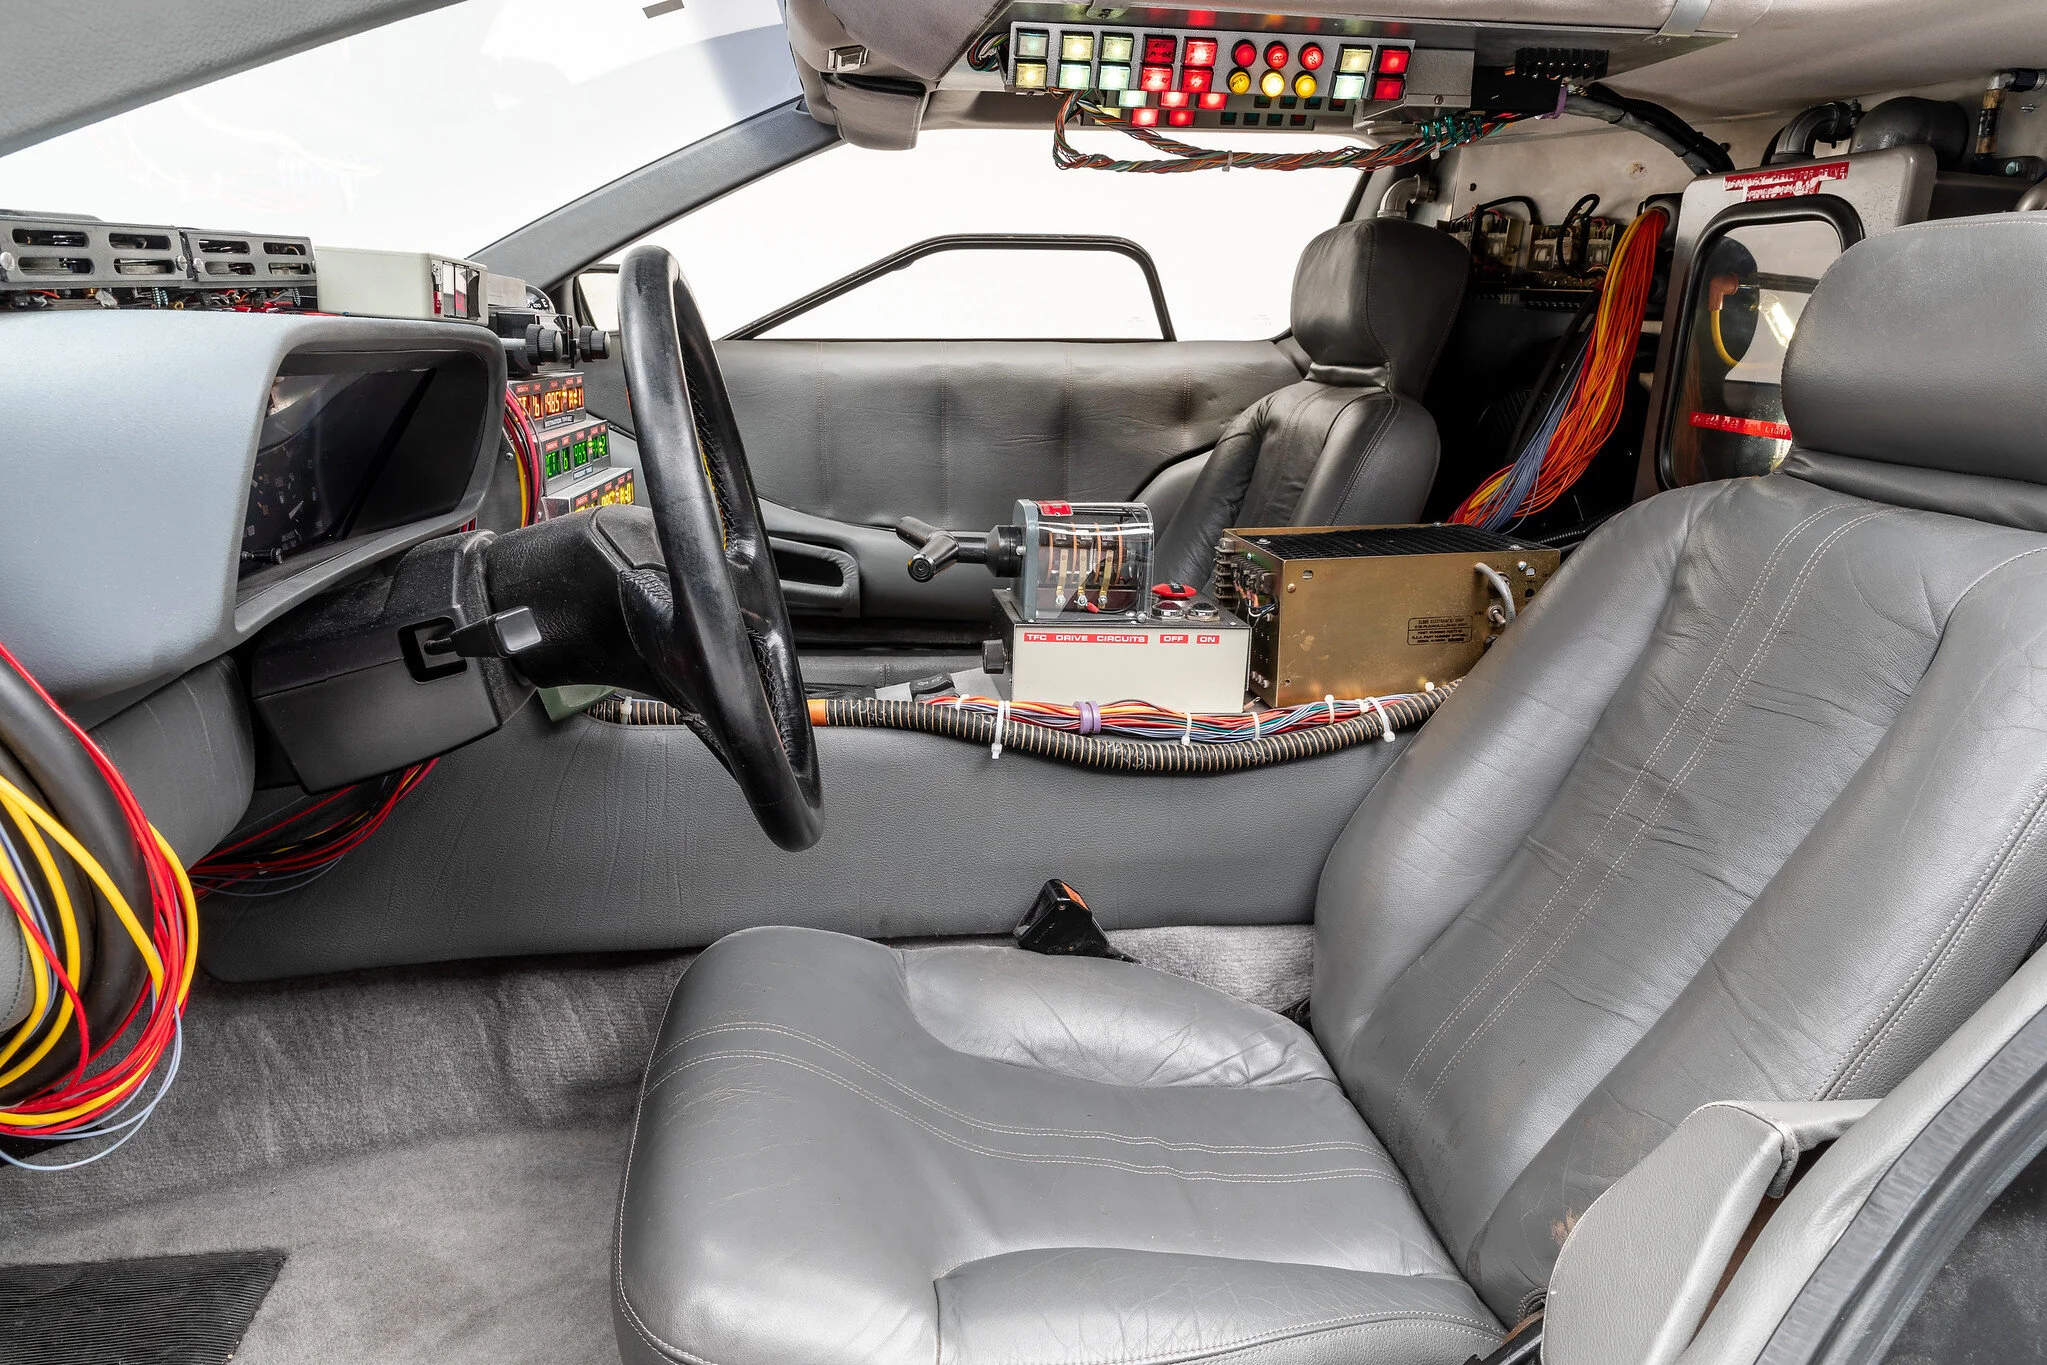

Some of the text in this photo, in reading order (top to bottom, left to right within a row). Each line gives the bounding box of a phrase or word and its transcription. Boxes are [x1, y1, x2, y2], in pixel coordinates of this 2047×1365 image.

[1026, 633, 1146, 643] TFC DRIVE CIRCUITS
[1162, 635, 1184, 643] OFF
